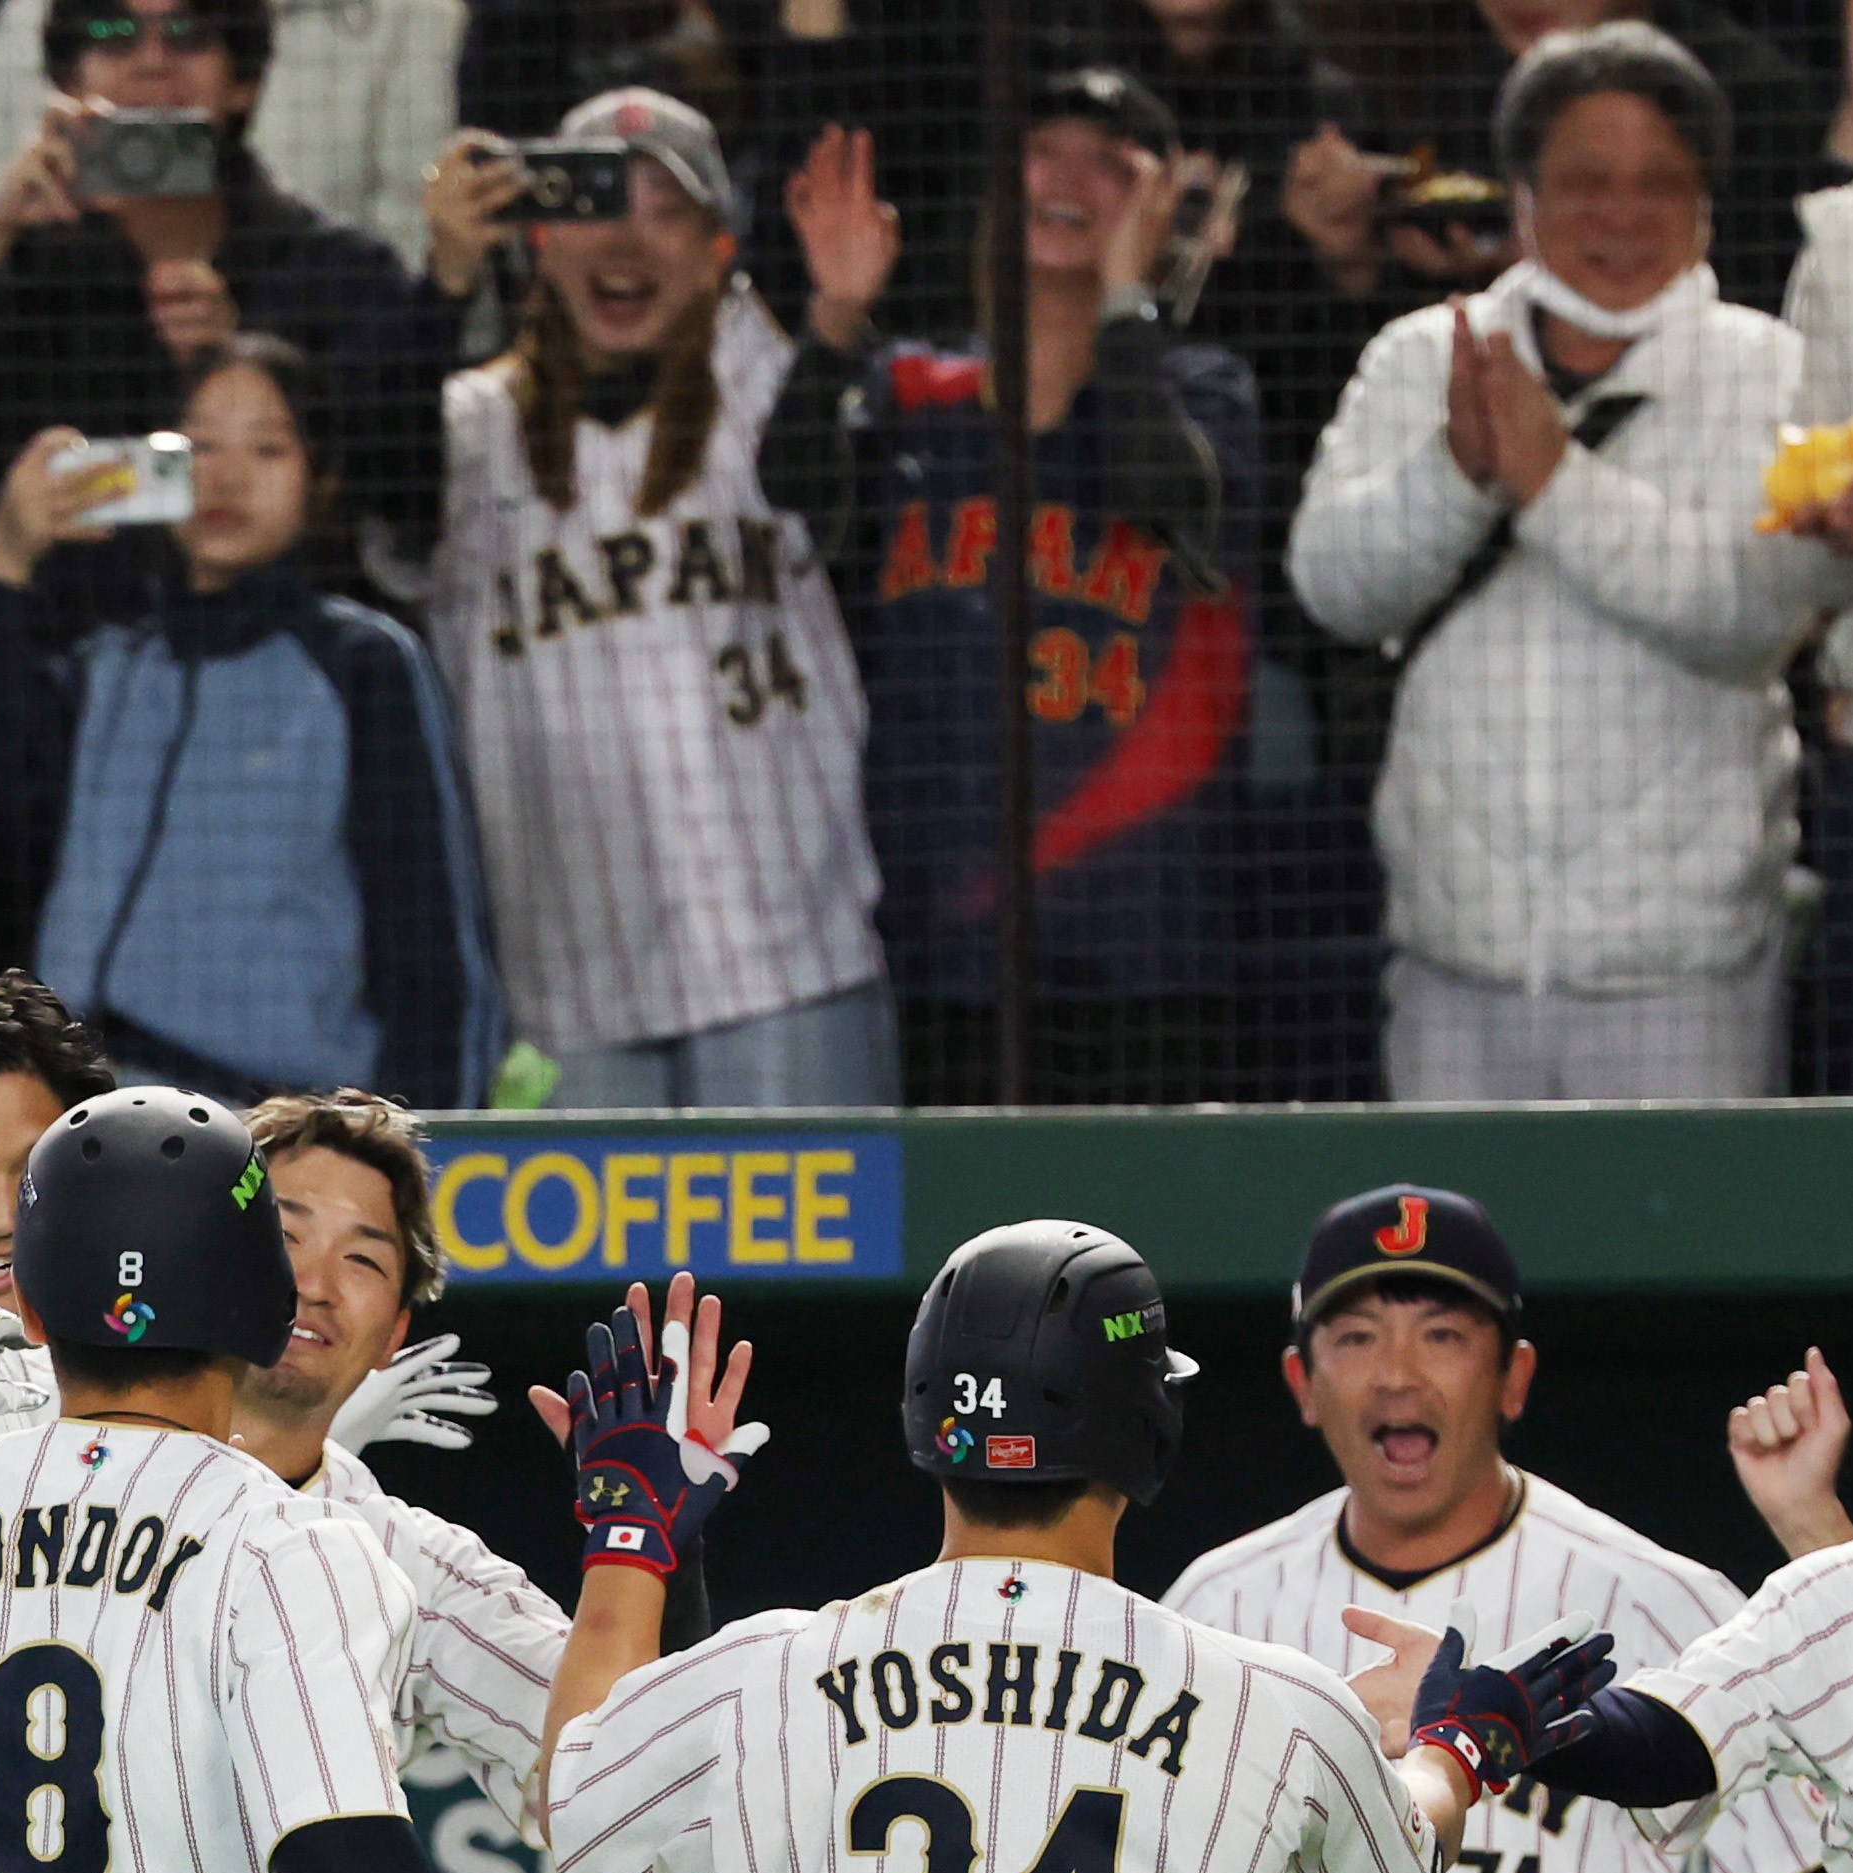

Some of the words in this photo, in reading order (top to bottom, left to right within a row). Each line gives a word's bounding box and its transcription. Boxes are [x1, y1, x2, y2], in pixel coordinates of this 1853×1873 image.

[880, 500, 1171, 625] APAN
[718, 630, 808, 728] 34
[1027, 626, 1148, 728] 34
[431, 1150, 856, 1270] COFFEE
[1374, 1195, 1429, 1257] J
[117, 1250, 145, 1288] 8
[1102, 1310, 1145, 1343] NX
[952, 1372, 1008, 1419] 34
[814, 1641, 1206, 1780] YOSHIDA
